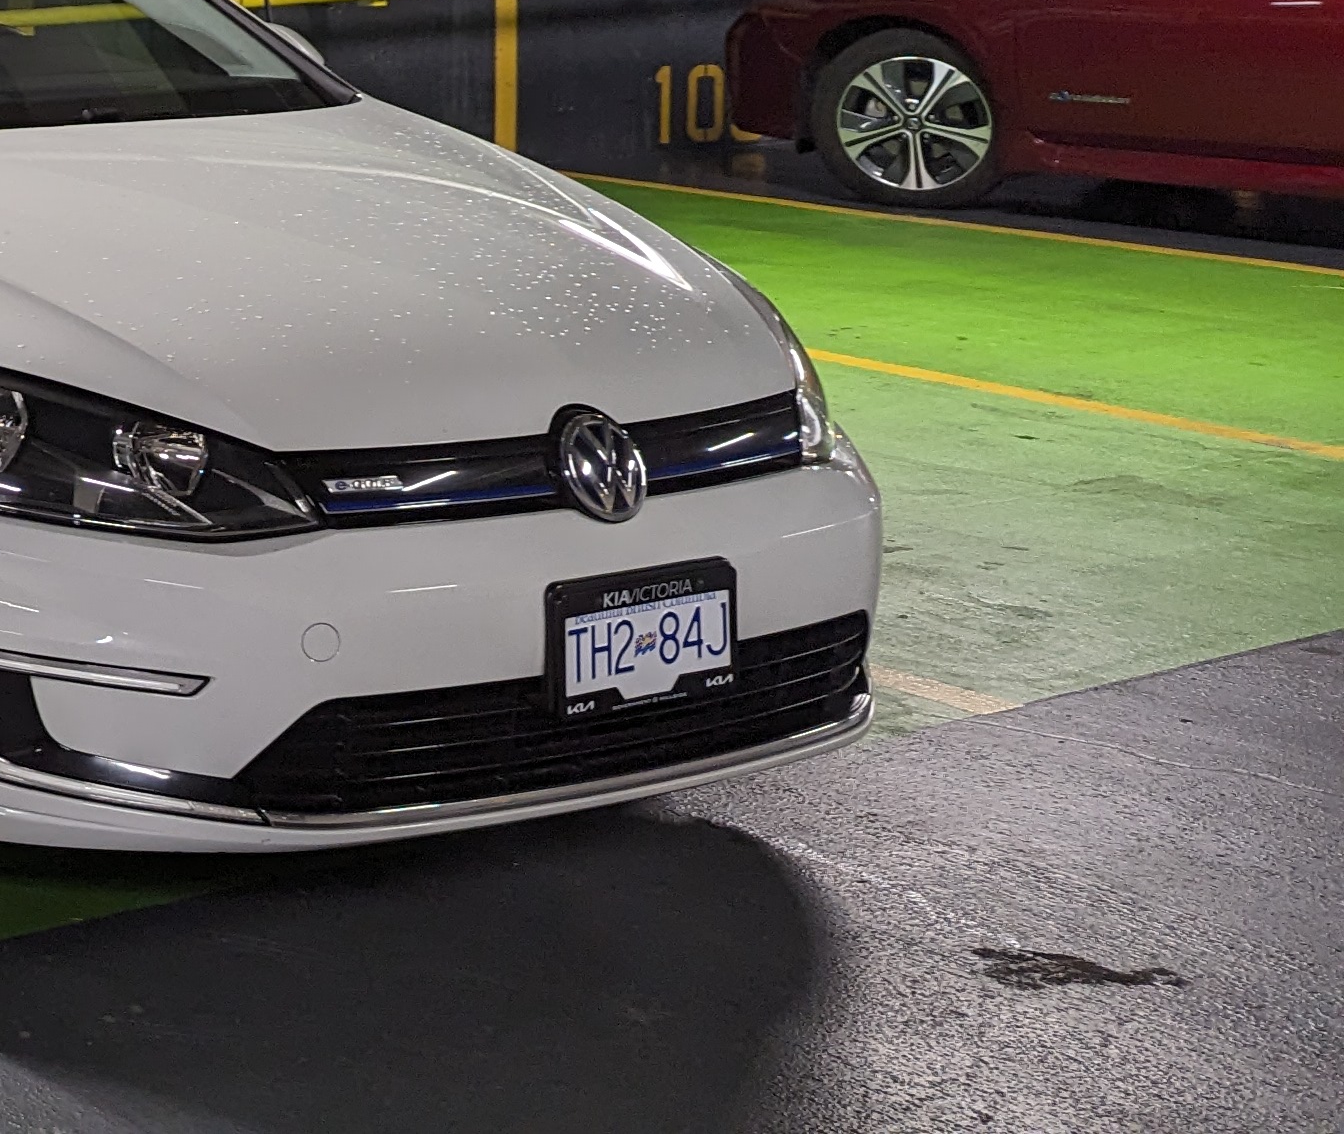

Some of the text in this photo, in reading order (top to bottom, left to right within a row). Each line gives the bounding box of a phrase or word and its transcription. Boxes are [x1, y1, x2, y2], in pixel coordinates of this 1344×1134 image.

[654, 64, 763, 144] 10
[567, 602, 728, 683] TH2 84J
